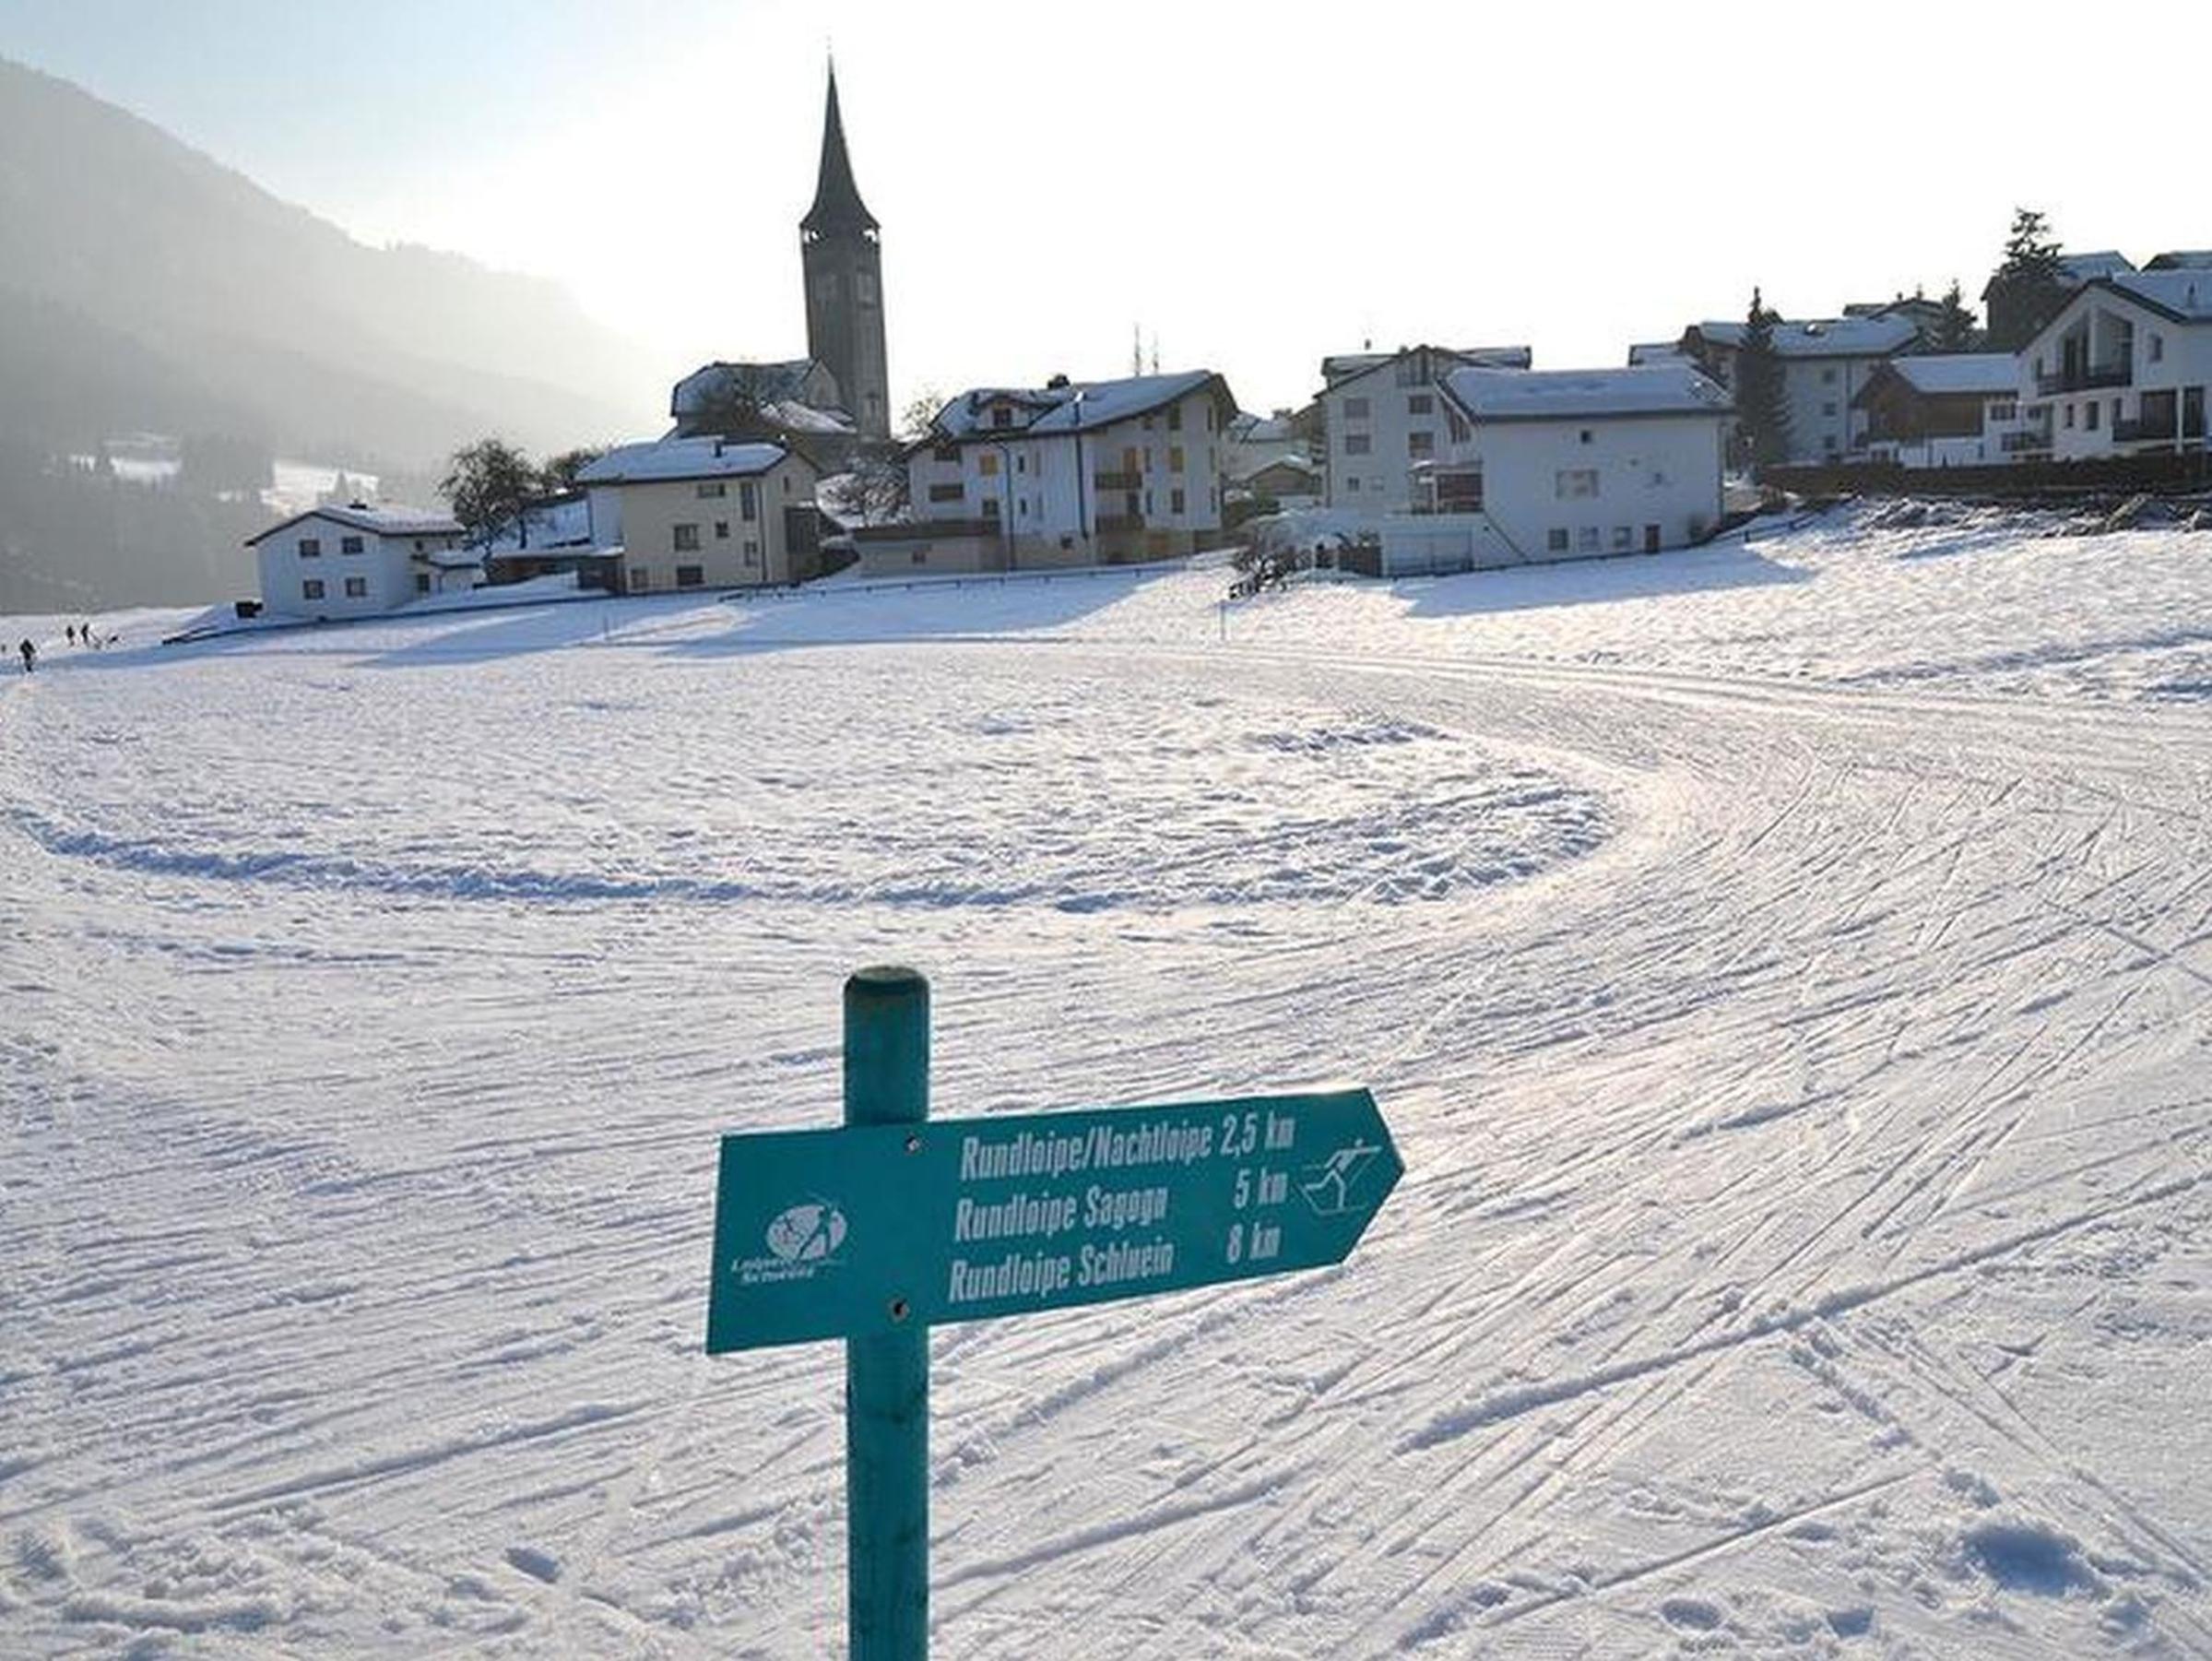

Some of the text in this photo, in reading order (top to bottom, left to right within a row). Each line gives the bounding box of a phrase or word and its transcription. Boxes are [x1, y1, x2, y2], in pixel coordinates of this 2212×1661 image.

[960, 1110, 1295, 1180] Rundloipe/Nachtloipe 2,5 km
[954, 1192, 1077, 1243] Rundloipe
[1234, 1168, 1251, 1209] 5
[1257, 1166, 1288, 1205] km
[949, 1252, 1071, 1303] Rundloipe
[1226, 1223, 1244, 1264] 8
[1249, 1220, 1281, 1260] km
